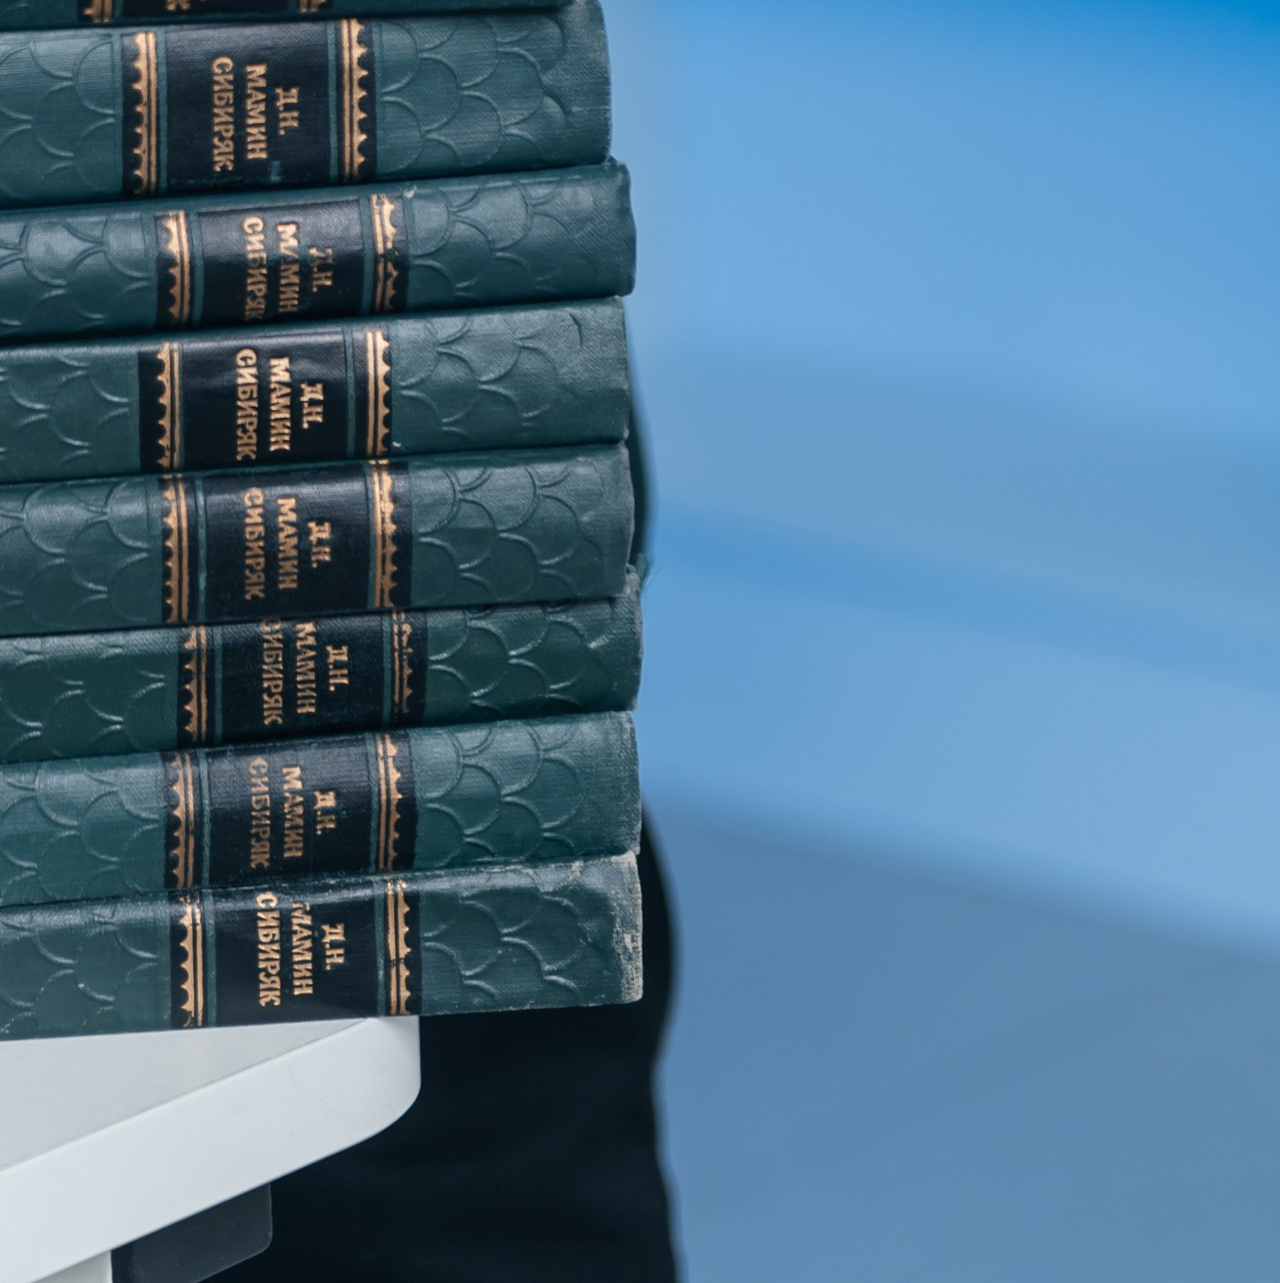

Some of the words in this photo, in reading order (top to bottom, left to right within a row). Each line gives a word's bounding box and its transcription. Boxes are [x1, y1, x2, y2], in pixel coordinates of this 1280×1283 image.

[211, 56, 235, 172] СИБИРЯК
[245, 63, 268, 160] МАМИН
[235, 348, 258, 460] СИБИРЯК
[268, 356, 292, 452] МАМИН
[243, 488, 265, 599] СИБИРЯК
[276, 496, 299, 589] МАМИН
[261, 617, 284, 724] СИБИРЯК
[295, 621, 316, 714] МАМИН
[250, 758, 271, 869] СИБИРЯК
[282, 766, 304, 857] МАМИН
[255, 891, 282, 1007] СИБИРЯК
[291, 902, 314, 996] МАМИН
